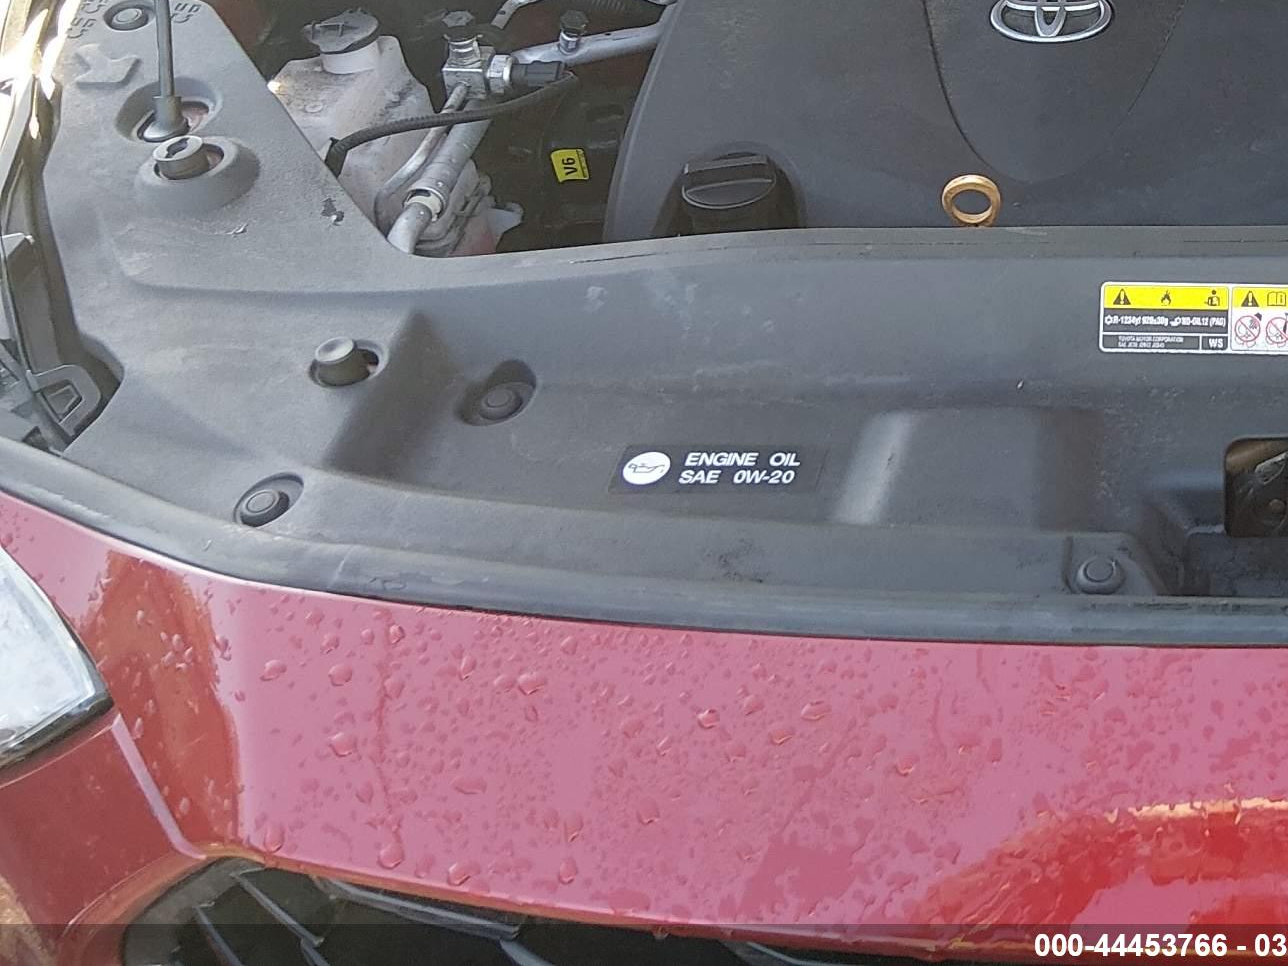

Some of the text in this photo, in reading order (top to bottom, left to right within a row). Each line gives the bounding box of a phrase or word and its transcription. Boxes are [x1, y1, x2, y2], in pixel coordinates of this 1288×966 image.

[561, 157, 578, 176] V6
[1208, 337, 1224, 349] WS
[684, 452, 801, 467] ENGINE OIL
[678, 470, 796, 484] SAE 0W-20
